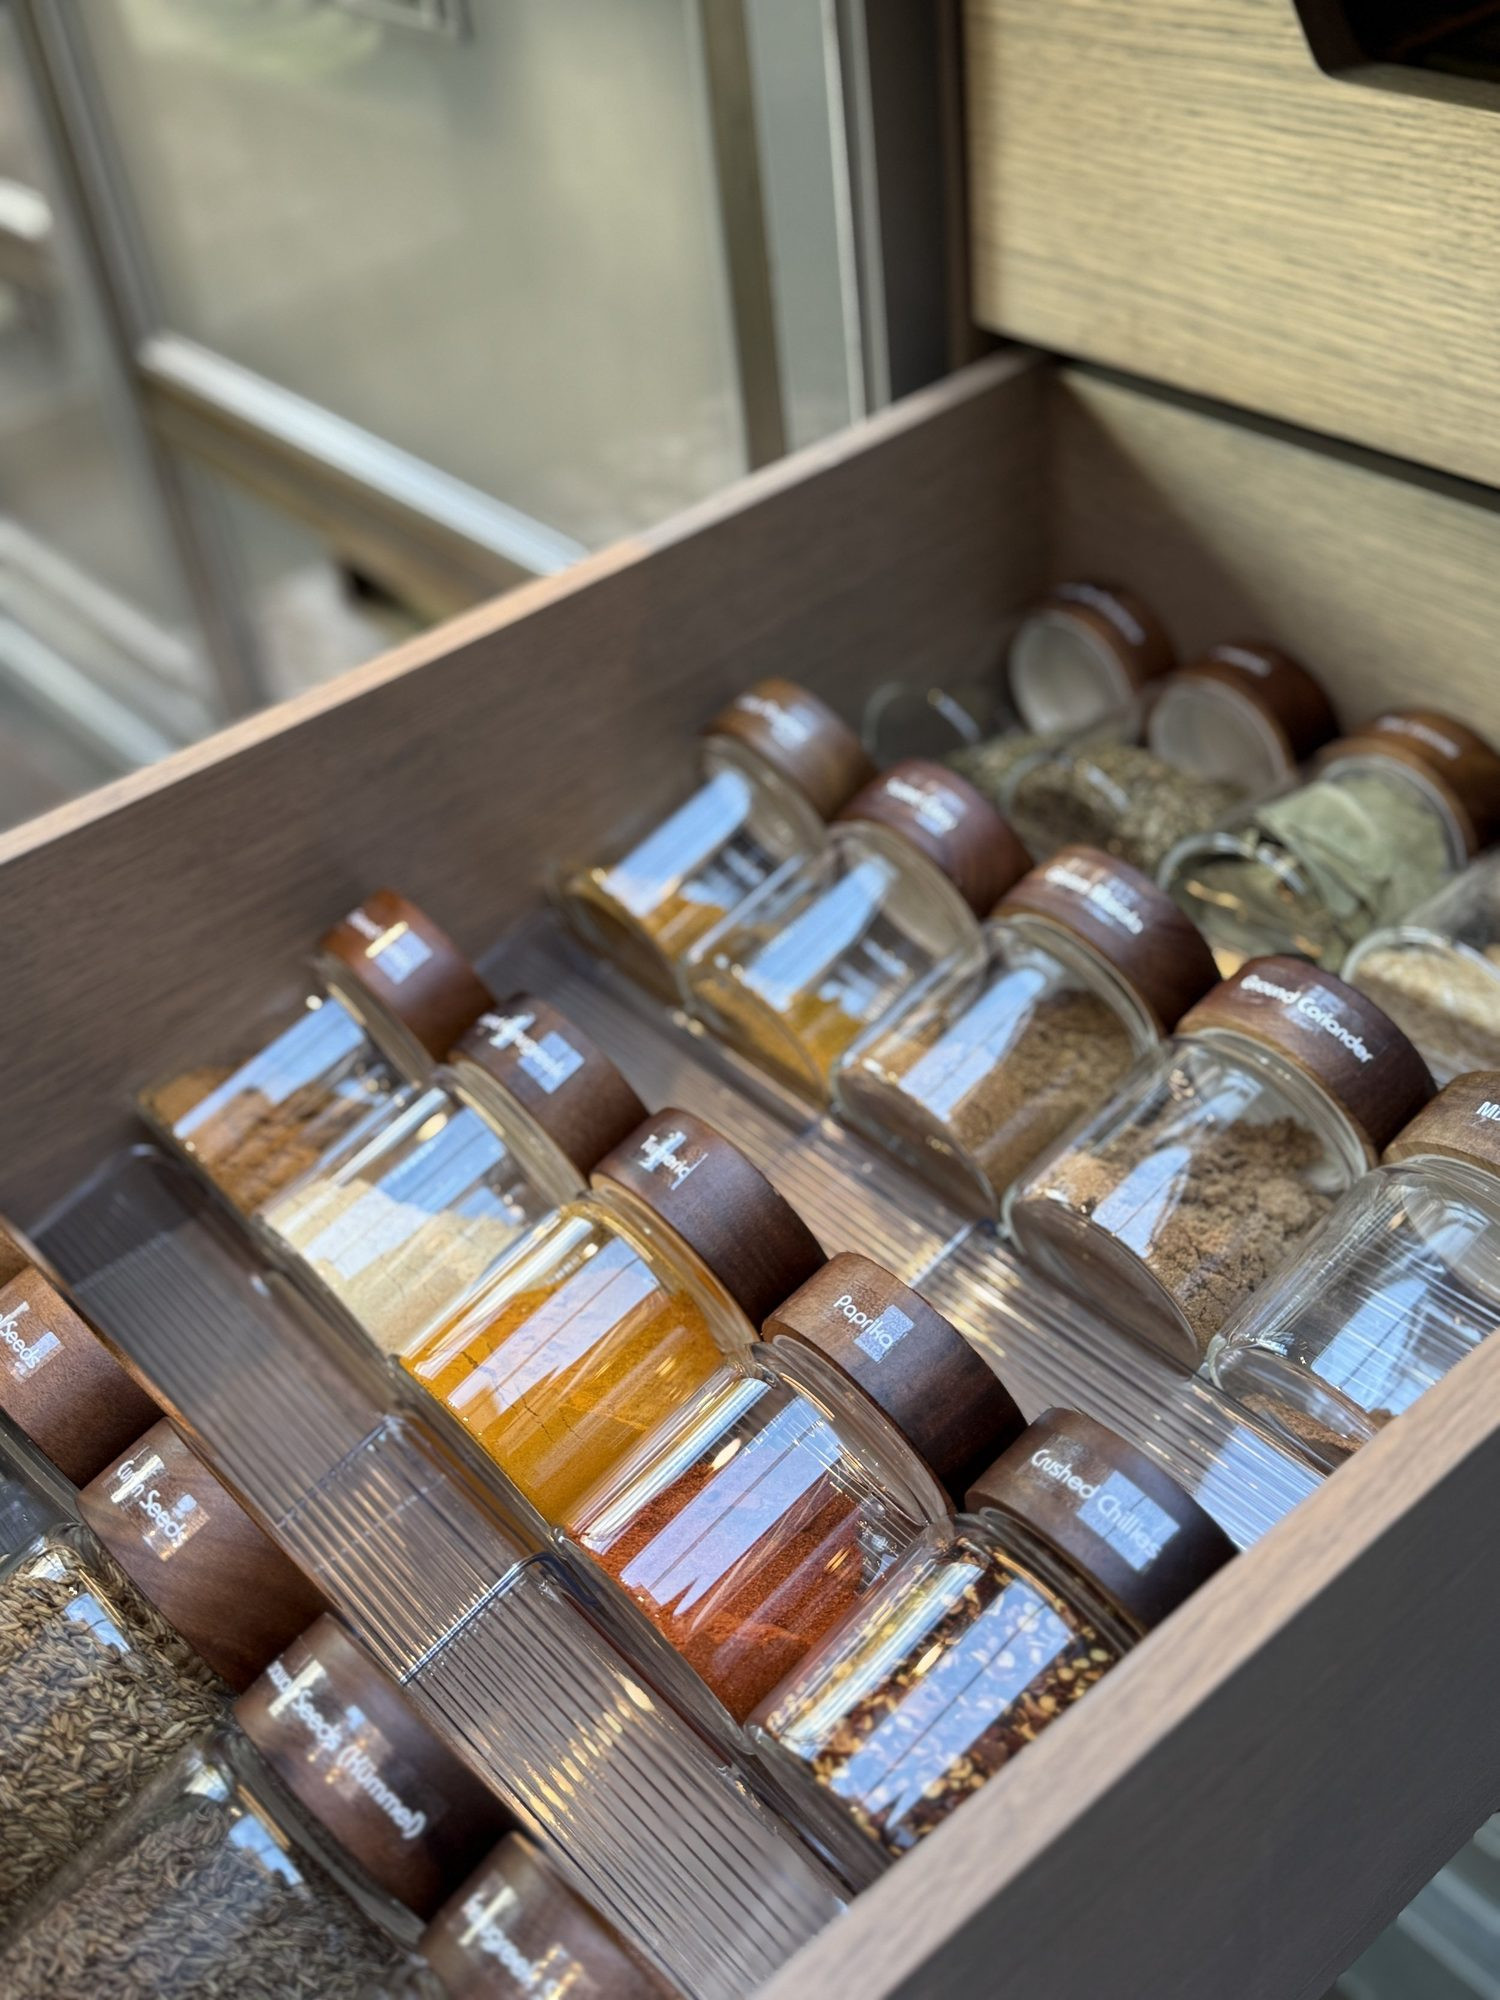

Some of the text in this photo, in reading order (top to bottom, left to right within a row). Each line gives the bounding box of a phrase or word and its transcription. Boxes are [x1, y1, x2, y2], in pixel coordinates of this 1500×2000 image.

[1297, 996, 1374, 1062] Coriander
[640, 1133, 692, 1176] Tureric
[0, 1320, 40, 1369] Seeds
[833, 1294, 894, 1350] Paprika
[139, 1489, 188, 1549] Seeds
[1031, 1449, 1162, 1560] Crushed Chillies
[290, 1688, 343, 1751] Seeds
